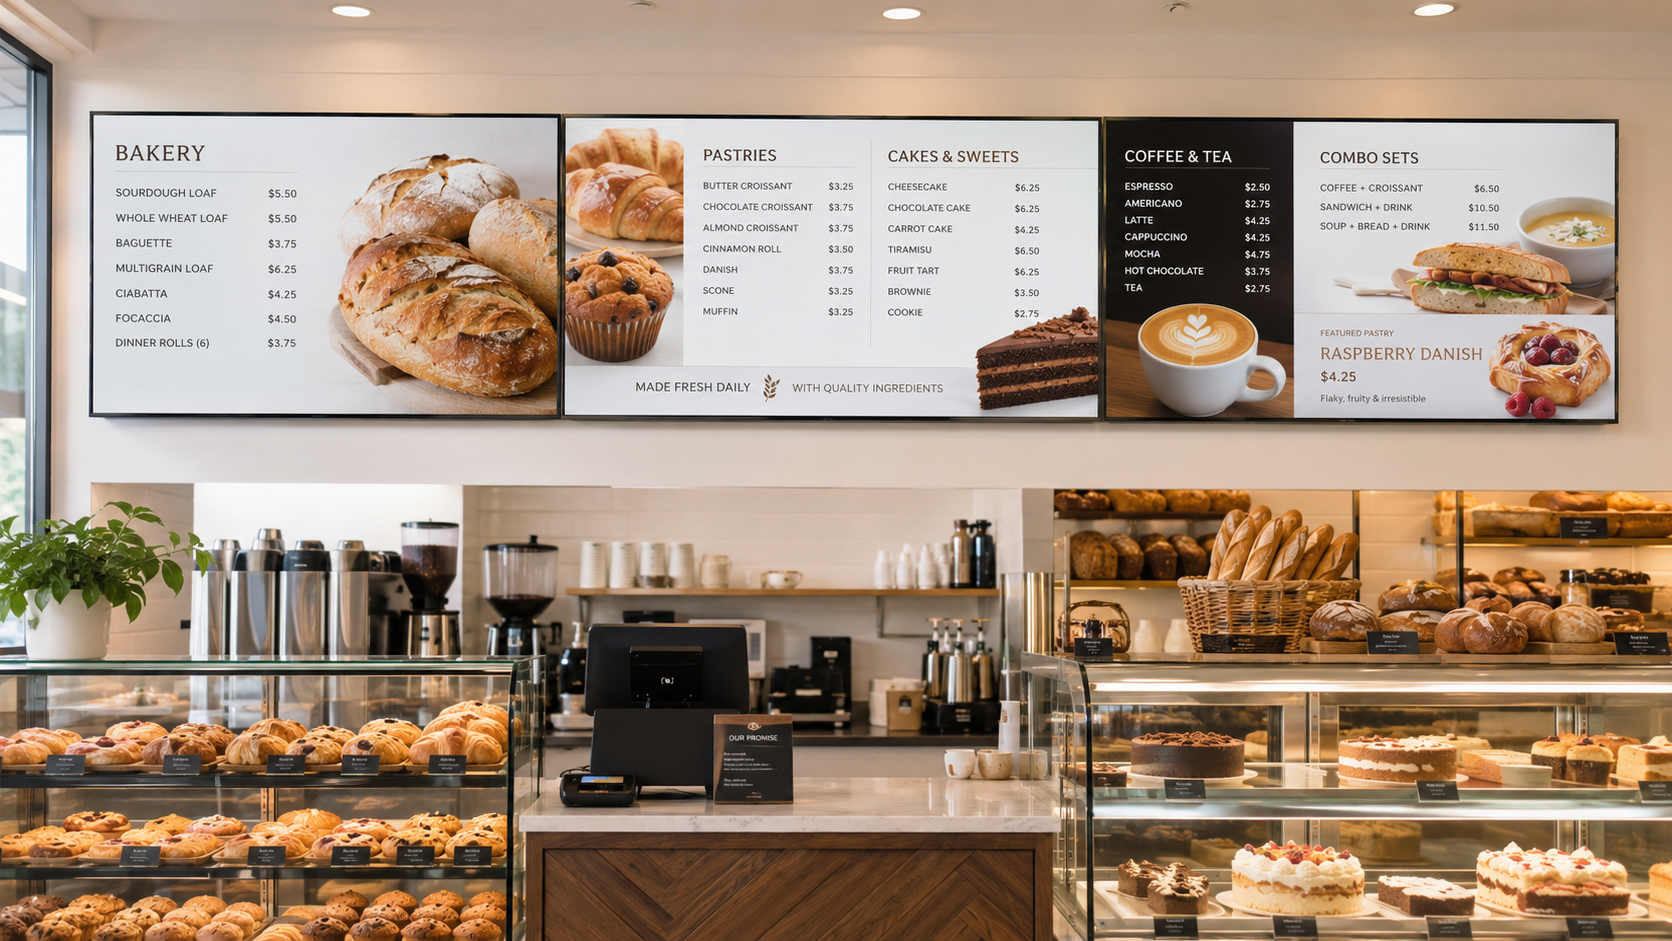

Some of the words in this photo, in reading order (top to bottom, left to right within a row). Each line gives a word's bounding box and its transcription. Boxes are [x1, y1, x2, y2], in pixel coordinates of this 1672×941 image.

[115, 144, 205, 162] BAKERY
[703, 148, 777, 162] PASTRIES
[887, 149, 939, 163] CAKES
[942, 150, 953, 163] &
[957, 150, 1019, 163] SWEETS
[1124, 149, 1184, 163] COFFEE
[1187, 150, 1199, 163] &
[1202, 150, 1233, 163] TEA
[1320, 151, 1379, 165] COMBO
[1382, 151, 1419, 165] SETS
[703, 181, 739, 191] BUTTER
[740, 181, 793, 191] CROISSANT
[828, 181, 854, 191] $3.25
[887, 182, 948, 192] CHEESECAKE
[1014, 183, 1040, 193] $6.25
[1124, 181, 1174, 191] ESPRESSO
[1244, 182, 1271, 192] $2.50
[1319, 183, 1357, 193] COFFEE
[1368, 183, 1424, 193] CROISSANT
[1474, 183, 1500, 194] $6.50
[115, 187, 186, 198] SOURDOUGH
[189, 188, 217, 198] LOAF
[268, 188, 297, 199] $5.50
[702, 202, 759, 211] CHOCOLATE
[760, 202, 814, 212] CROISSANT
[828, 202, 854, 212] $3.75
[887, 203, 945, 213] CHOCOLATE
[945, 203, 971, 213] CAKE
[1014, 204, 1040, 214] $6.25
[1124, 199, 1183, 208] AMERICANO
[1244, 199, 1271, 209] $2.75
[1319, 202, 1373, 212] SANDWICH
[1383, 203, 1413, 212] DRINK
[1468, 203, 1500, 213] $10.50
[115, 213, 156, 223] WHOLE
[157, 213, 198, 223] WHEAT
[199, 213, 228, 223] LOAF
[268, 213, 297, 224] $5.50
[1124, 215, 1154, 225] LATTE
[1244, 216, 1271, 226] $4.25
[702, 223, 745, 232] ALMOND
[745, 223, 799, 233] CROISSANT
[828, 223, 854, 233] $3.75
[887, 224, 926, 233] CARROT
[927, 224, 953, 233] CAKE
[1319, 221, 1347, 231] SOUP
[1357, 222, 1390, 231] BREAD
[1400, 222, 1431, 231] DRINK
[1468, 222, 1500, 232] $11.50
[1124, 232, 1188, 242] CAPPUCCINO
[1244, 232, 1271, 243] $4.25
[115, 238, 173, 248] BAGUETTE
[268, 238, 297, 249] $3.75
[702, 244, 756, 253] CINNAMON
[757, 244, 782, 254] ROLL
[828, 244, 854, 254] $3.50
[887, 245, 933, 255] TIRAMISU
[1014, 246, 1040, 256] $6.50
[1124, 249, 1161, 259] MOCHA
[1244, 249, 1271, 260] $4.75
[115, 263, 183, 273] MULTIGRAIN
[185, 263, 214, 274] LOAF
[267, 263, 297, 275] $6.25
[702, 265, 739, 274] DANISH
[828, 265, 854, 275] $3.75
[887, 266, 915, 275] FRUIT
[916, 266, 940, 275] TART
[1014, 267, 1040, 277] $6.25
[1124, 266, 1145, 275] HOT
[1146, 266, 1205, 276] CHOCOLATE
[1244, 266, 1271, 277] $3.75
[702, 286, 735, 295] SCONE
[828, 286, 854, 296] $3.25
[887, 287, 932, 296] BROWNIE
[1014, 288, 1040, 298] $3.50
[1124, 283, 1144, 292] TEA
[1244, 283, 1271, 293] $2.75
[115, 288, 168, 299] CIABATTA
[267, 289, 297, 300] $4.25
[702, 307, 739, 316] MUFFIN
[828, 307, 854, 317] $3.25
[887, 307, 923, 317] COOKIE
[1014, 309, 1040, 319] $2.75
[115, 313, 172, 324] FOCACCIA
[267, 313, 297, 325] $4.50
[1320, 329, 1363, 337] FEATURED
[1363, 329, 1395, 337] PASTRY
[115, 338, 157, 348] DINNER
[159, 338, 194, 348] ROLLS
[196, 338, 210, 350] (6)
[267, 337, 297, 349] $3.75
[1320, 346, 1416, 361] RASPBERRY
[1420, 347, 1483, 361] DANISH
[1320, 370, 1357, 384] $4.25
[635, 381, 671, 393] MADE
[674, 381, 713, 393] FRESH
[716, 381, 751, 393] DAILY
[792, 383, 821, 393] WITH
[823, 383, 870, 395] QUALITY
[872, 383, 944, 394] INGREDIENTS
[1320, 393, 1346, 405] Flaky,
[1347, 393, 1371, 405] fruity
[1372, 393, 1380, 403] &
[1381, 394, 1427, 403] irresistible
[728, 734, 745, 742] OUR
[745, 734, 778, 742] PROMISE
